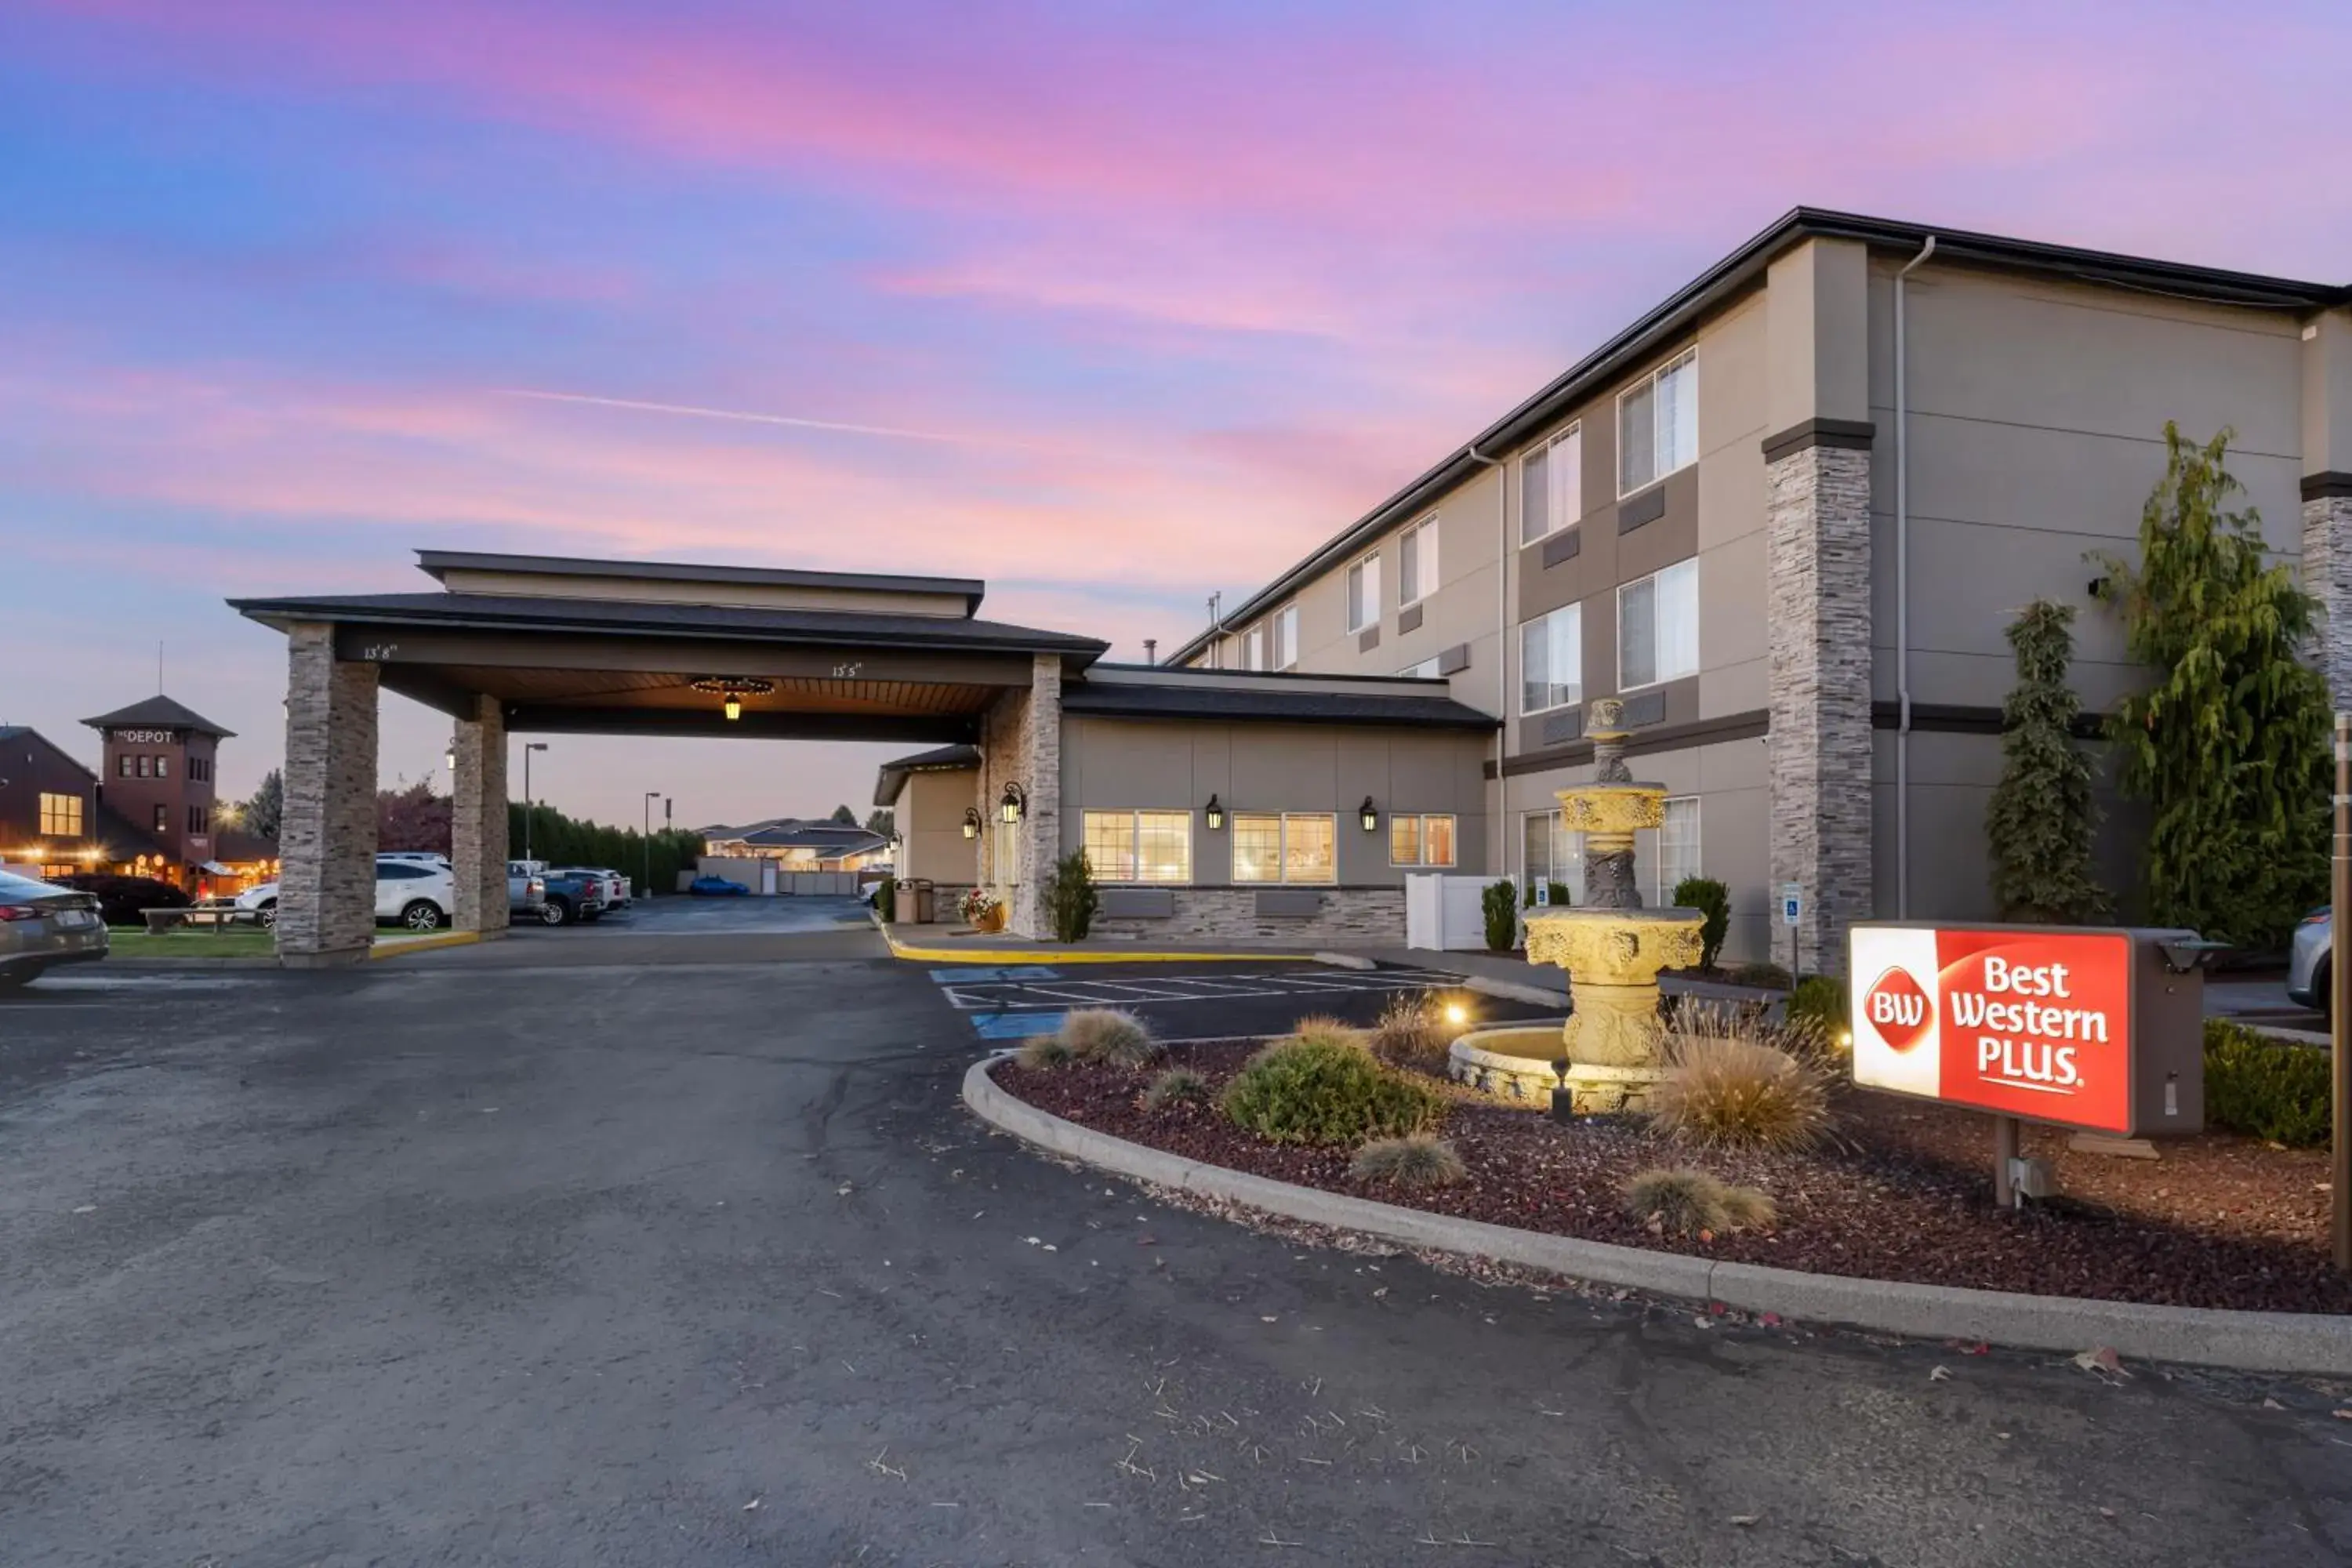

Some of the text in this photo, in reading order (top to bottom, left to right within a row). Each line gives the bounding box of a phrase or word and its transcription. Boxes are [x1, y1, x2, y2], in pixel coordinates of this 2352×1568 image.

[127, 730, 173, 743] DEPOT
[1984, 956, 2071, 999] Best
[1873, 991, 1923, 1027] BW
[1951, 991, 2108, 1043] Western
[1978, 1037, 2077, 1086] PLUS
